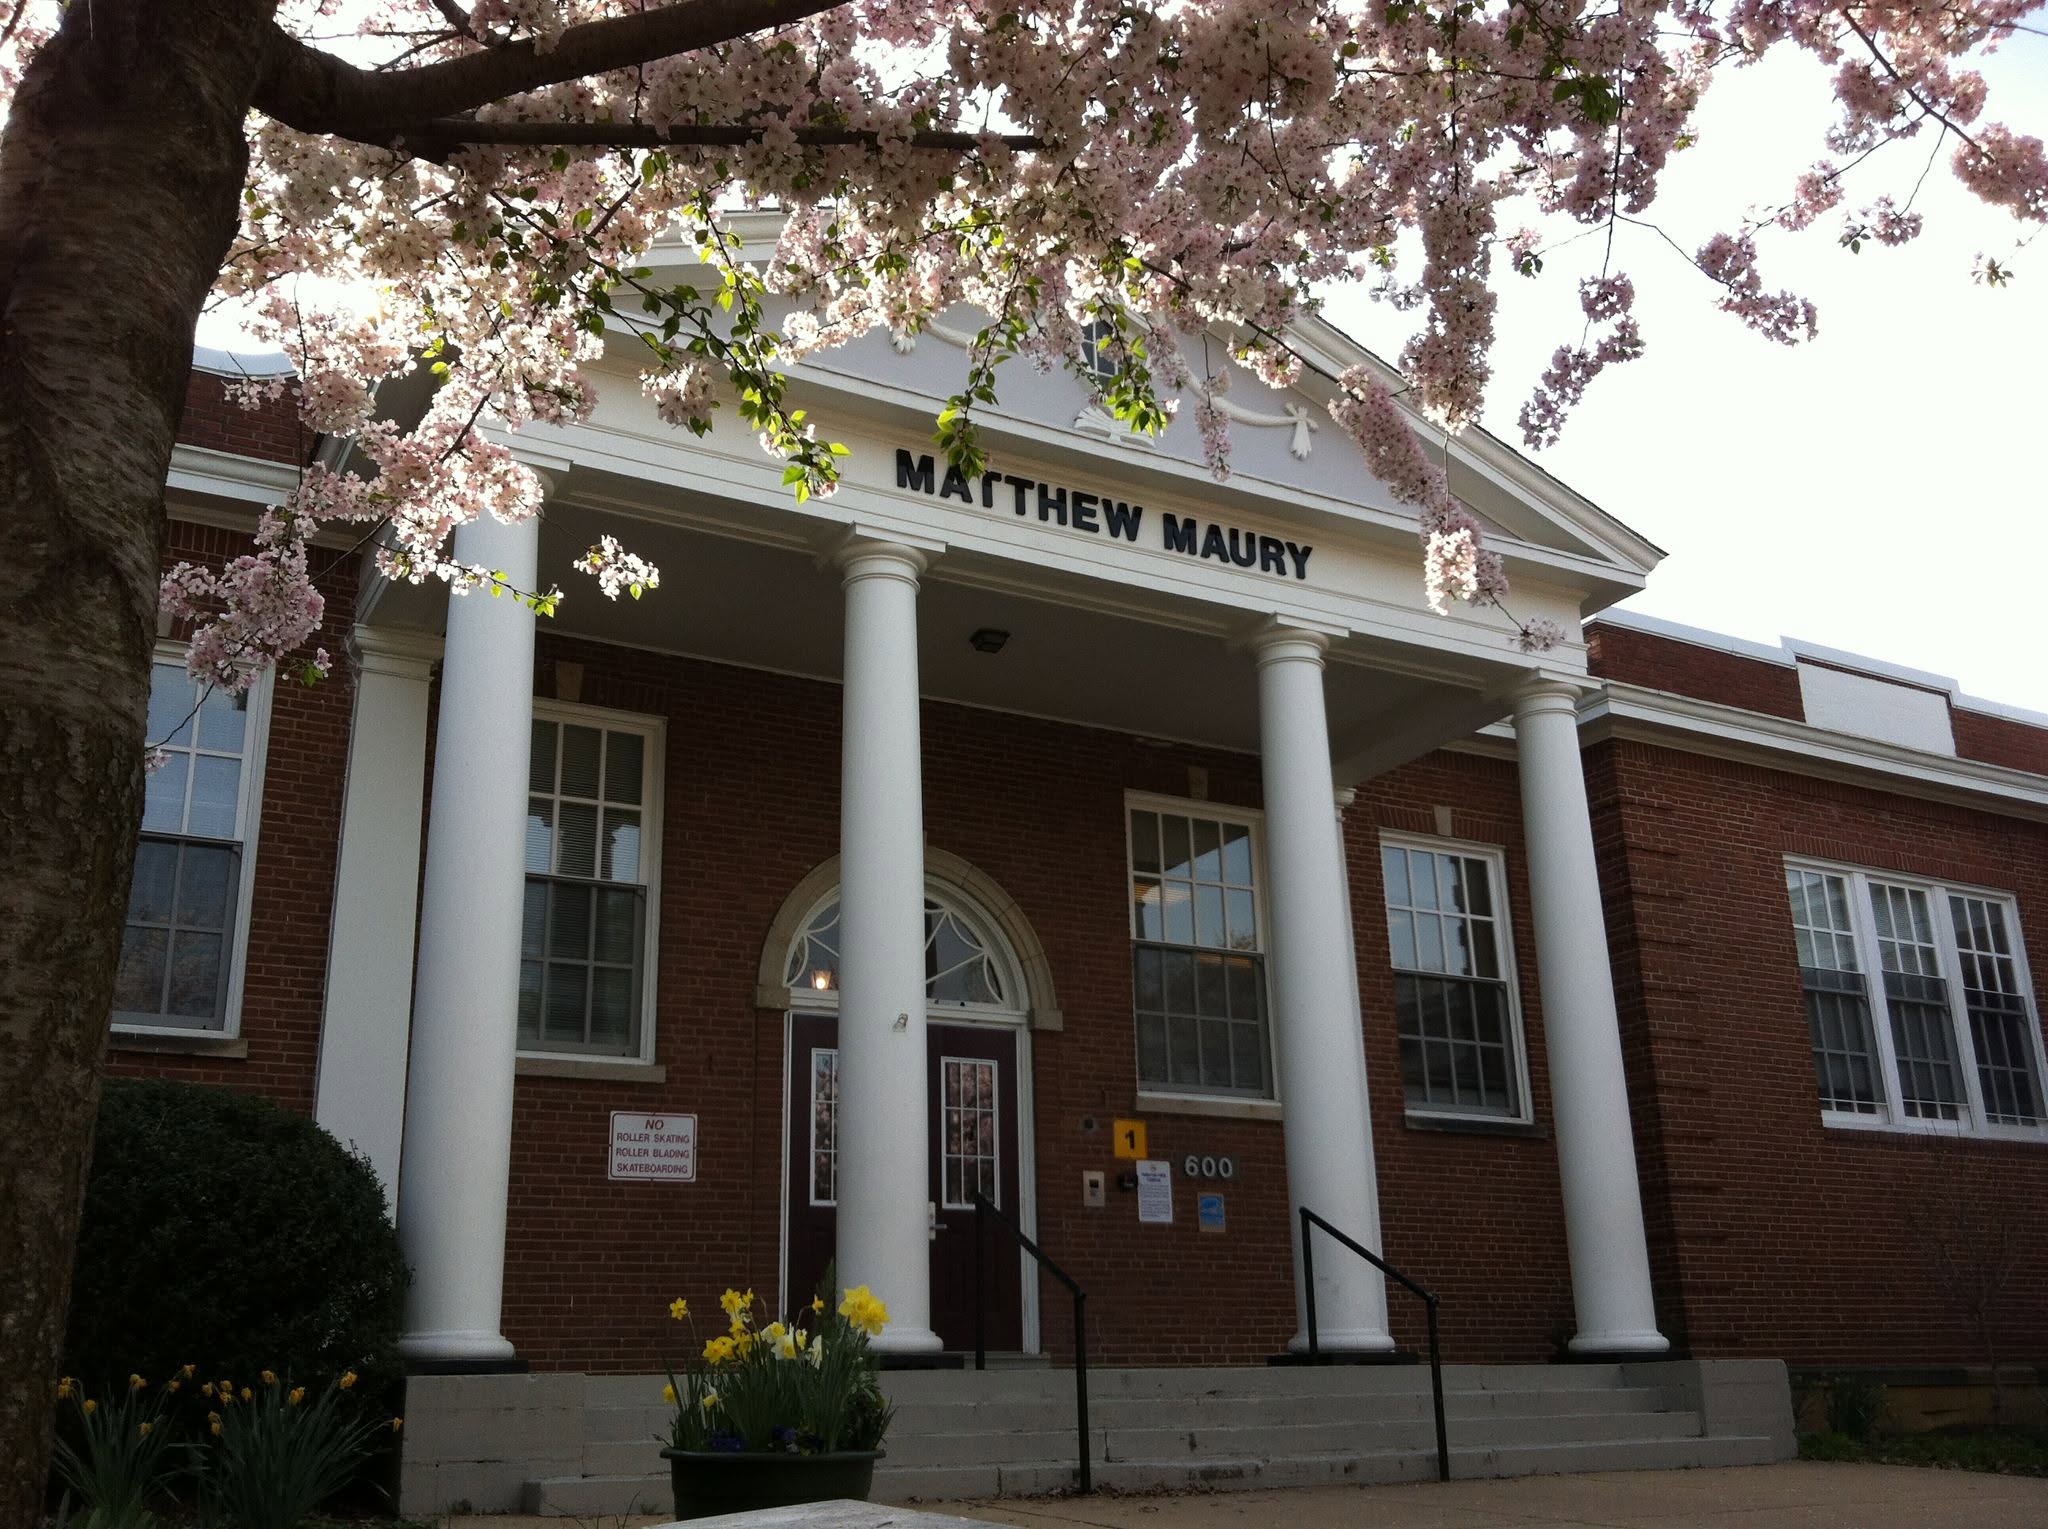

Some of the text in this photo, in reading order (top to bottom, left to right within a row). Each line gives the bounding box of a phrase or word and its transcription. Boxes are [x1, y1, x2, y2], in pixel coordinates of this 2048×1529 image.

[896, 448, 1313, 580] MATTHEW MAURY
[645, 1119, 664, 1130] NO
[616, 1132, 690, 1144] ROLLER SKATING
[1125, 1129, 1136, 1150] 1
[616, 1148, 689, 1159] ROLLER BLADING
[617, 1163, 688, 1174] SKATEBOARDING
[1184, 1155, 1233, 1178] 600
